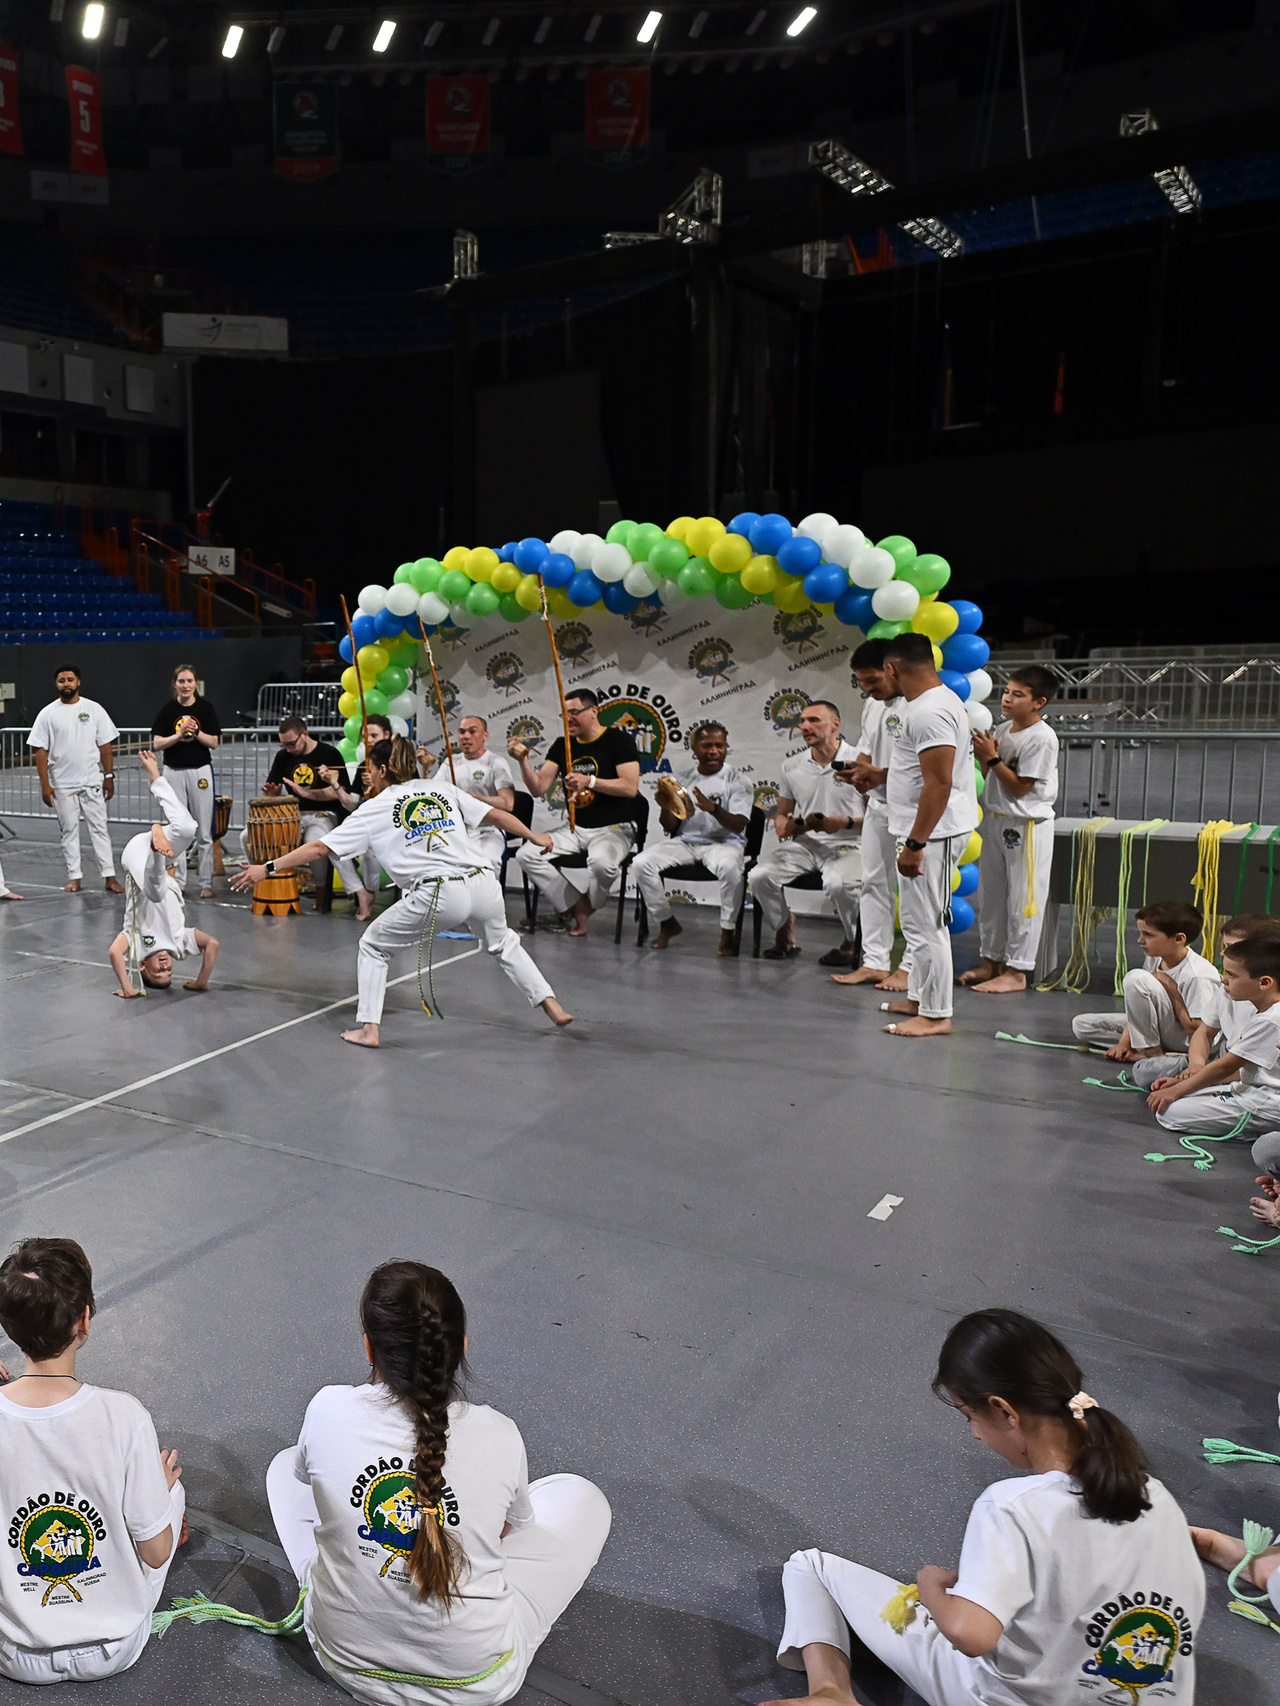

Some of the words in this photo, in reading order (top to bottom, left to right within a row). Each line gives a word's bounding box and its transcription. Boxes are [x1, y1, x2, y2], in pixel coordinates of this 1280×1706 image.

[78, 100, 91, 133] 5
[196, 553, 208, 568] A6
[218, 554, 230, 568] A5
[657, 620, 711, 647] КАЛИНИНГРАД
[788, 644, 849, 672] КАЛИНИНГРАД
[568, 660, 618, 685] КАЛИНИНГРАД
[700, 680, 757, 706] КАЛИНИНГРАД
[487, 697, 533, 720] КАЛИНИНГРАД
[626, 684, 650, 700] DE
[652, 694, 682, 743] OURO
[392, 794, 411, 828] CORDÃO
[430, 791, 453, 813] OURO
[404, 819, 456, 840] CAPOEIRA
[350, 1456, 403, 1508] CORDÃO
[440, 1480, 460, 1526] URO
[8, 1494, 50, 1548] CORDÃO
[54, 1491, 76, 1507] DE
[78, 1499, 107, 1542] OURO
[358, 1545, 378, 1554] MESTRE
[17, 1555, 102, 1577] CAPOEIRA
[77, 1572, 107, 1584] KALININGRAD
[84, 1579, 101, 1587] RUSSIA
[1085, 1591, 1146, 1648] CORDÃO
[1149, 1591, 1173, 1611] DE
[1173, 1606, 1193, 1656] OURO
